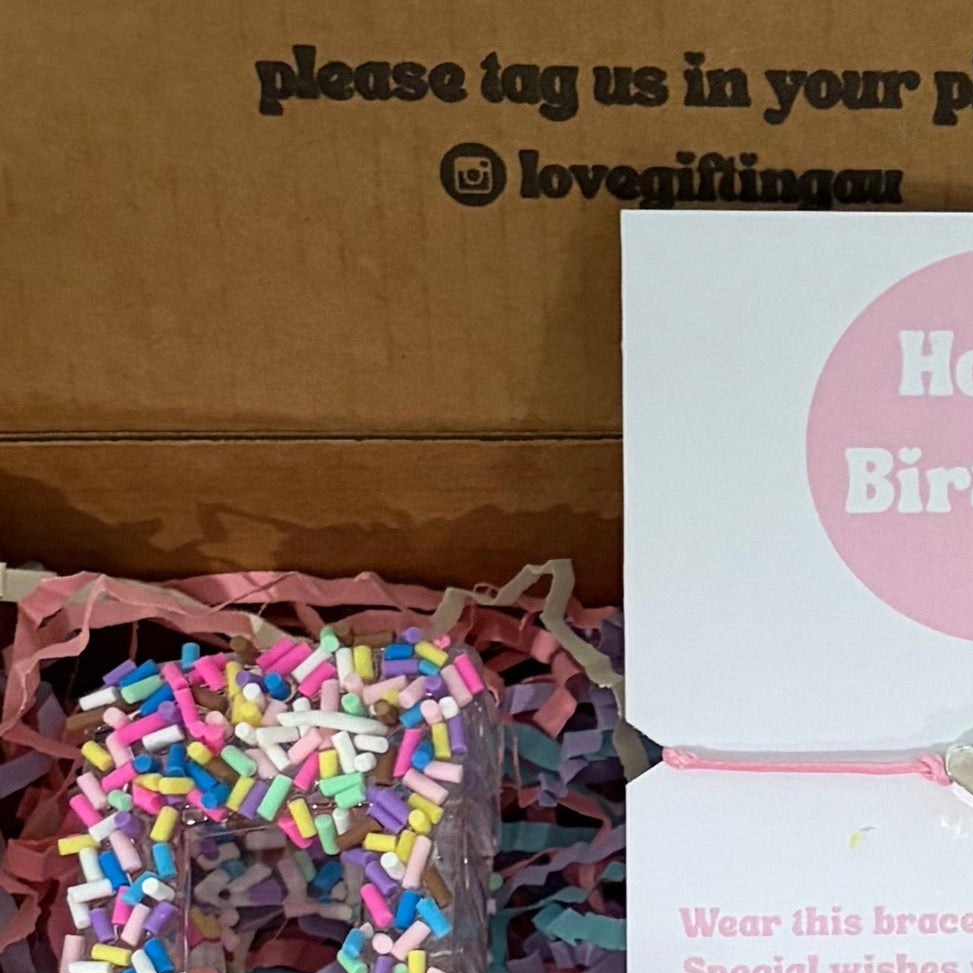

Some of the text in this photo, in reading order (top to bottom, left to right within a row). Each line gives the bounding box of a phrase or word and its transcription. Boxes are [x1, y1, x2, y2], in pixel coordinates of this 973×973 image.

[255, 44, 468, 116] please
[480, 52, 579, 121] tag
[593, 66, 669, 107] us
[683, 51, 751, 107] in
[763, 69, 921, 125] your
[678, 906, 783, 941] Wear
[791, 905, 864, 938] this
